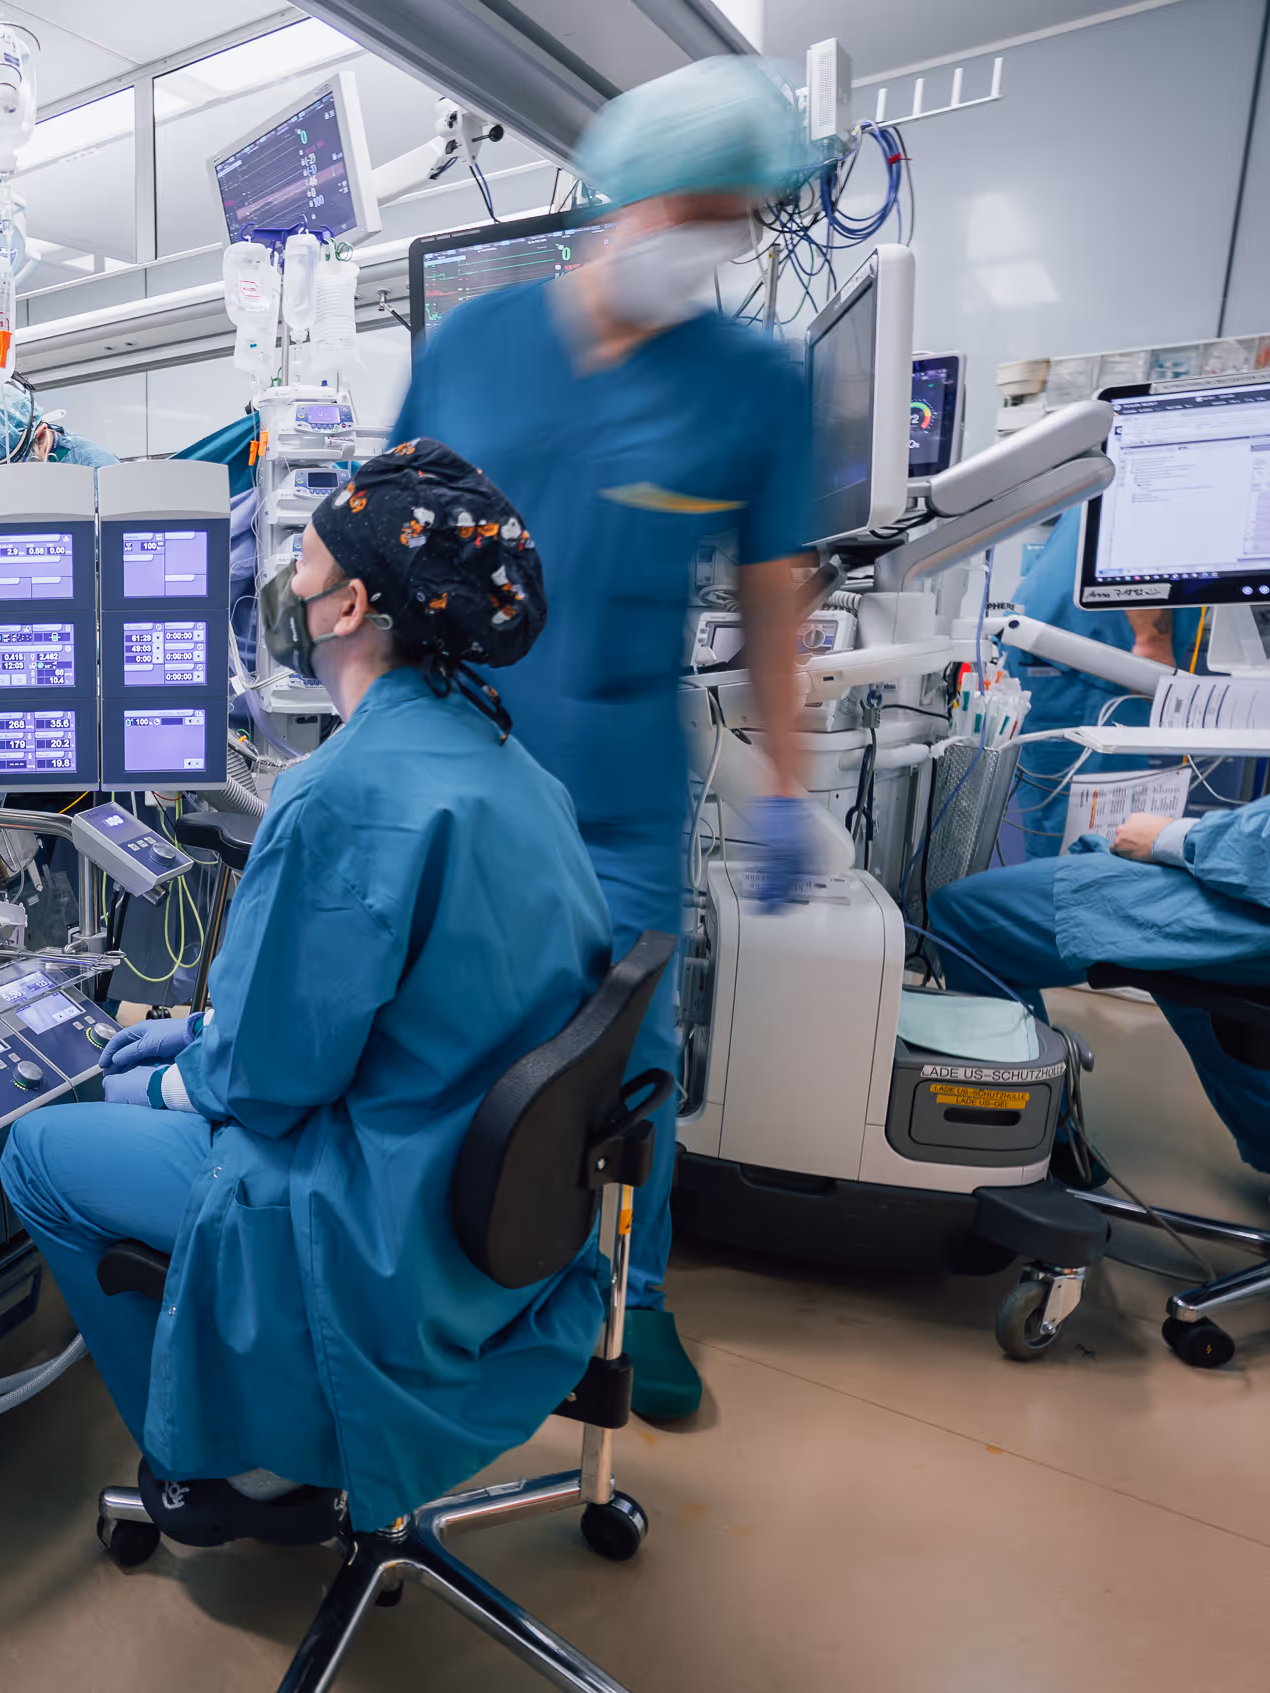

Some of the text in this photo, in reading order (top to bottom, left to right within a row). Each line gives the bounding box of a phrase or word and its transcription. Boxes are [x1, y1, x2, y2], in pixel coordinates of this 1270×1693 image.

[143, 542, 157, 550] 100
[6, 548, 19, 556] 2.9
[49, 546, 66, 554] 0.00
[165, 632, 193, 640] 0:00:00
[165, 652, 193, 660] 0:00:00
[165, 673, 193, 681] 0:00:00
[8, 719, 70, 729] 268 35.6
[9, 739, 70, 749] 179 20.2
[51, 759, 71, 768] 19.8
[921, 1066, 959, 1079] LADE
[934, 1085, 955, 1094] LADE
[955, 1096, 976, 1106] LADE
